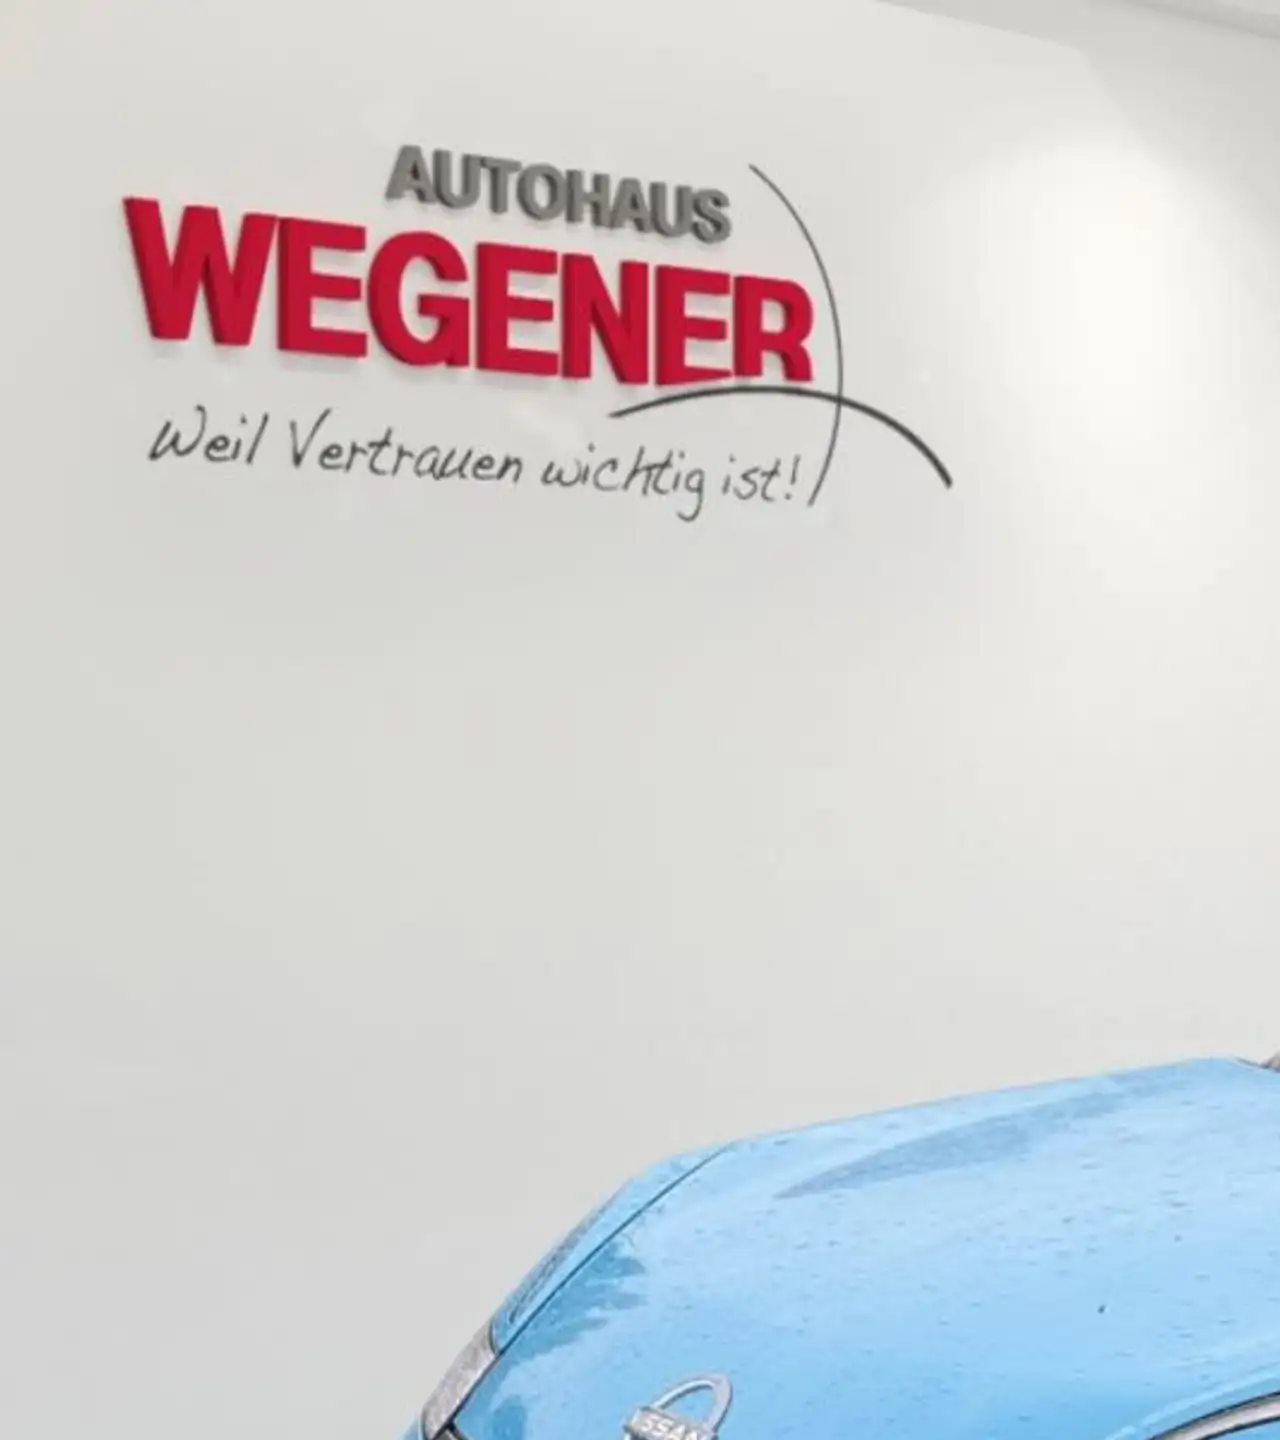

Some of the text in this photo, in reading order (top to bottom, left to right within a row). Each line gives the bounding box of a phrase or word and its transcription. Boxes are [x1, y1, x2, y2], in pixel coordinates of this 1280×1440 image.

[385, 145, 731, 244] AUTOHAUS
[124, 197, 814, 386] WEGENER
[148, 404, 800, 522] Weil Vertrauen wichtig ist!
